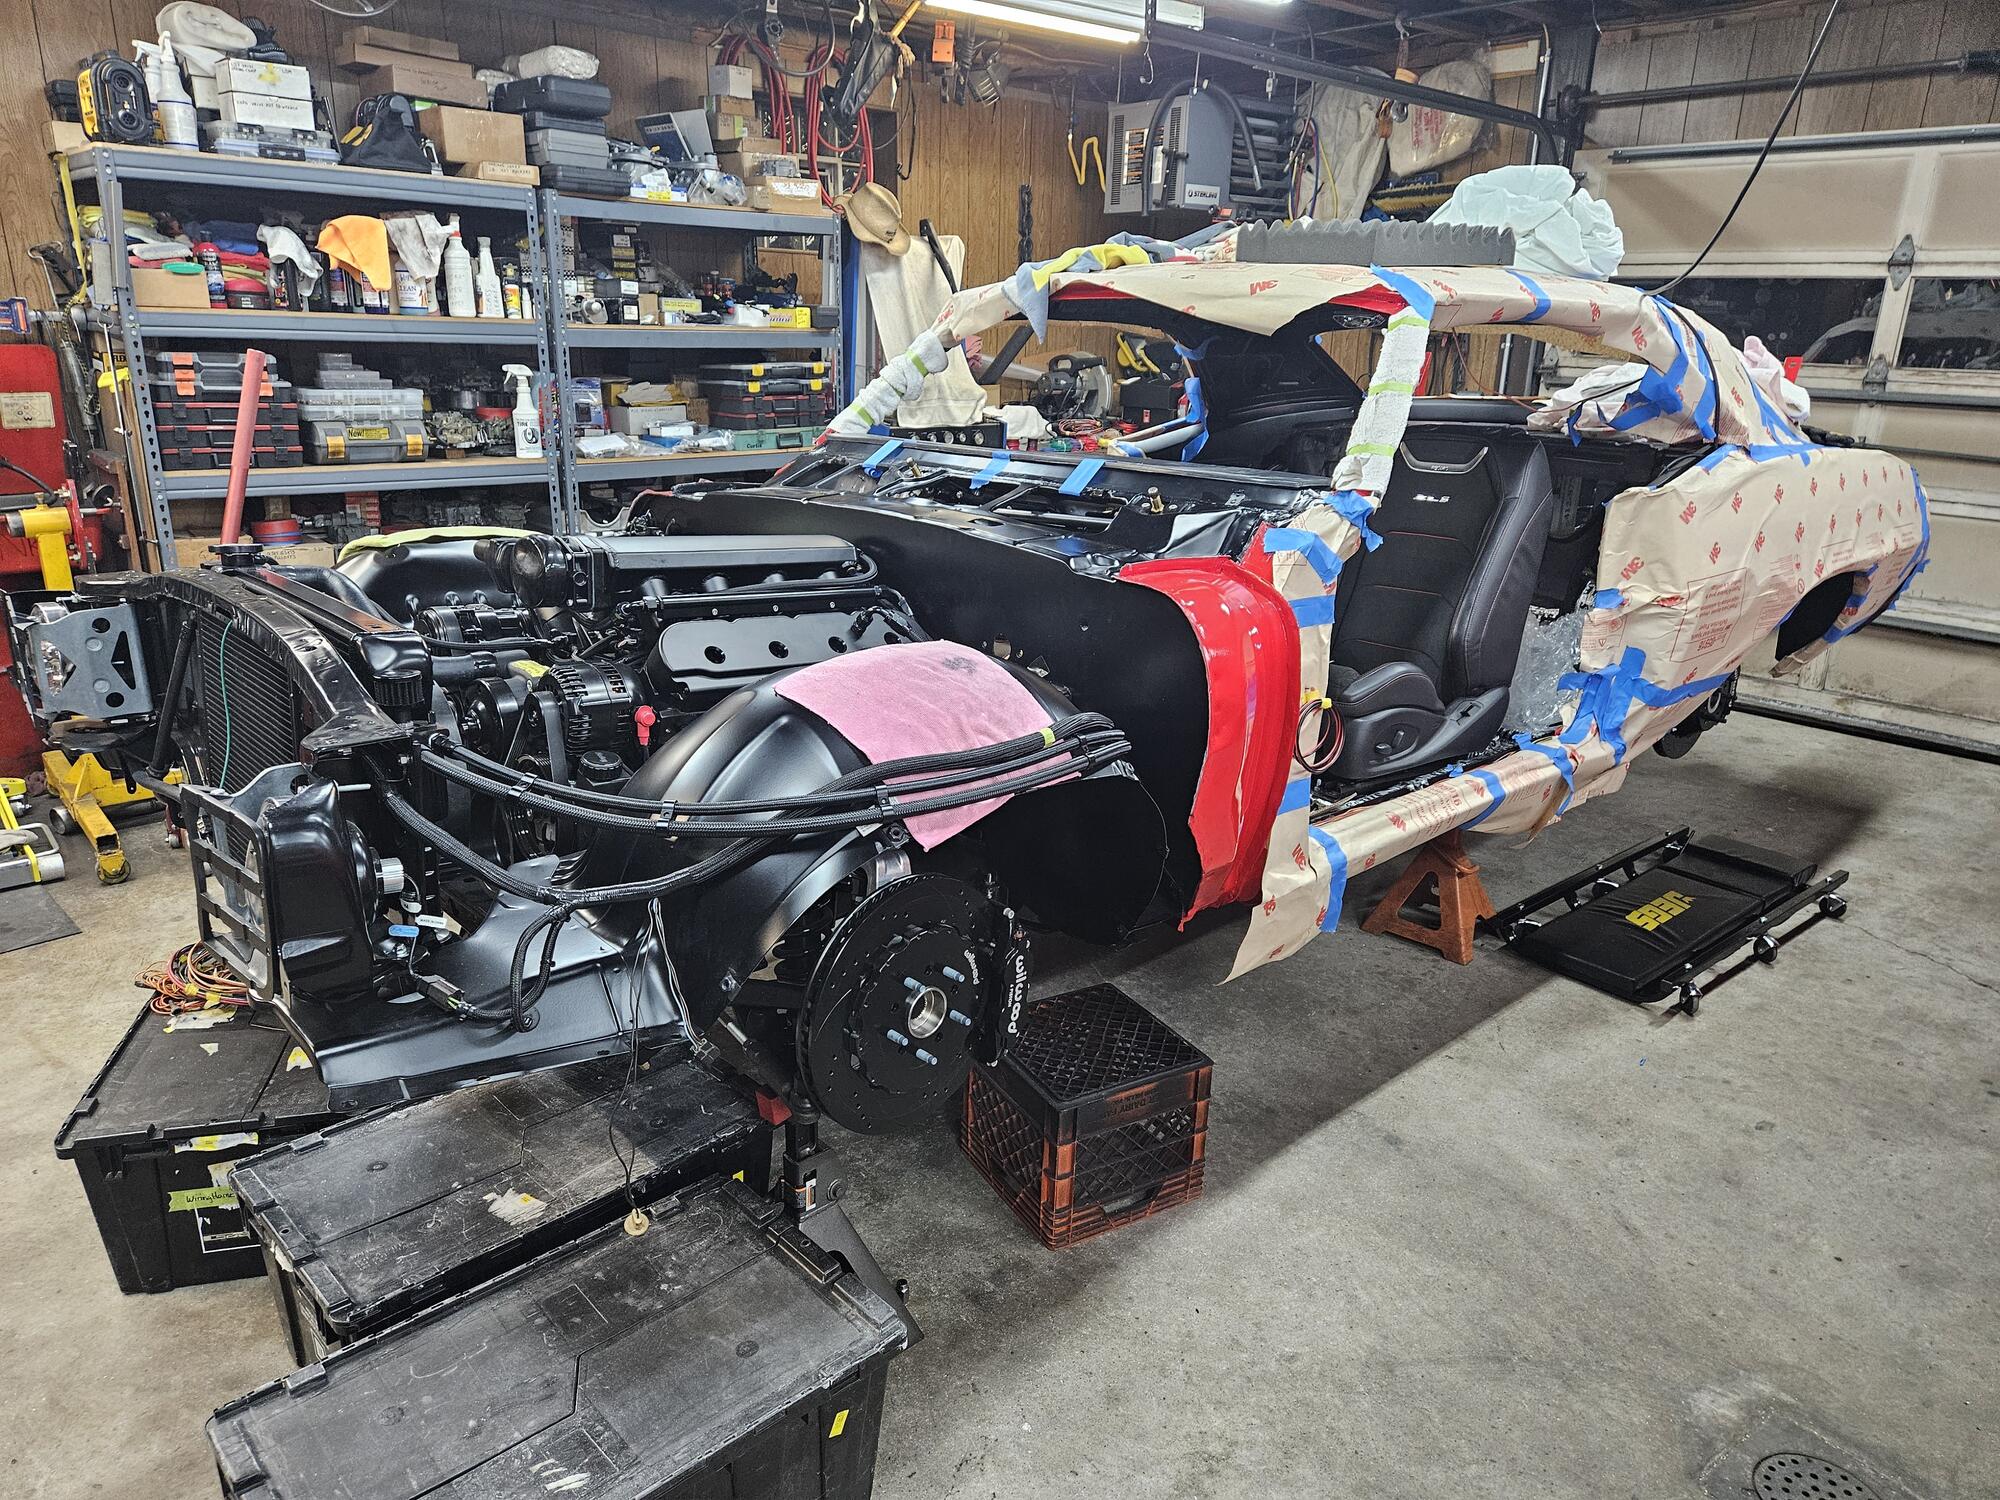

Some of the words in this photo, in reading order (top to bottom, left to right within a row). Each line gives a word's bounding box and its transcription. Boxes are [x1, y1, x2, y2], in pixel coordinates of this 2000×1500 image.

[1249, 279, 1279, 296] 3M
[1631, 325, 1648, 351] 3M
[1730, 387, 1745, 409] 3M
[348, 428, 365, 439] New!
[1774, 483, 1784, 505] 3M
[1810, 476, 1818, 497] 3M
[1679, 500, 1697, 525] 3M
[1731, 490, 1743, 515] 3M
[1754, 530, 1766, 553] 3M
[1794, 521, 1805, 544] 3M
[1708, 541, 1722, 565] 3M
[1620, 556, 1645, 581] 3M
[1814, 558, 1825, 579] 3M
[1388, 813, 1407, 832] 3M
[1291, 843, 1307, 871] 3M
[1625, 890, 1692, 932] JEGS
[963, 949, 980, 985] wilwood
[1007, 954, 1028, 1034] wilwood
[186, 1193, 213, 1203] Wiring
